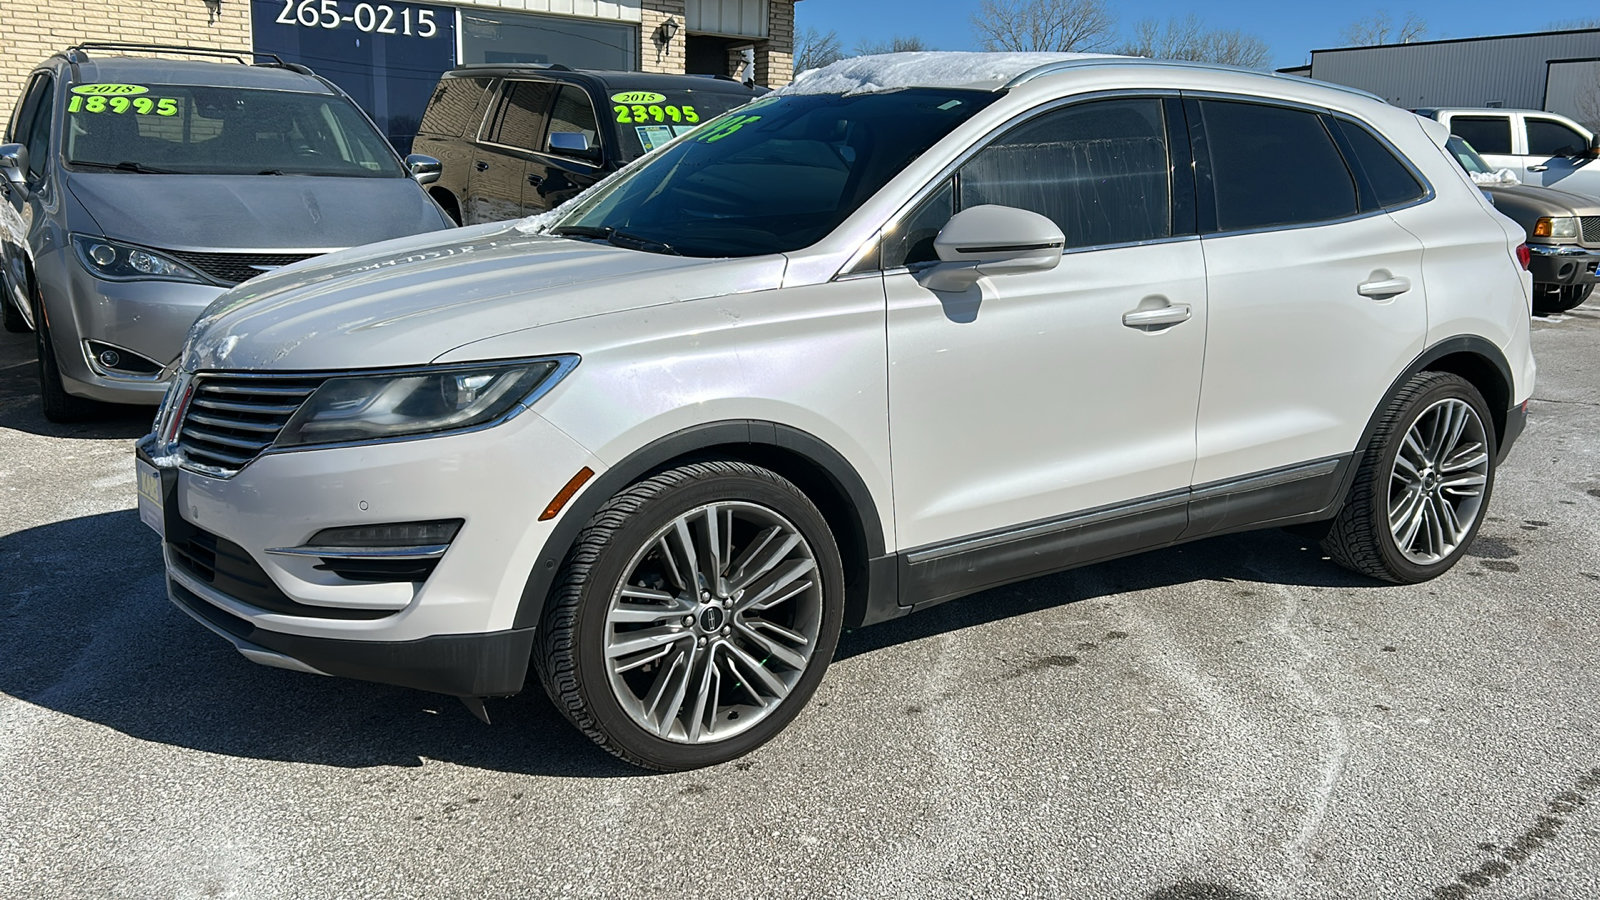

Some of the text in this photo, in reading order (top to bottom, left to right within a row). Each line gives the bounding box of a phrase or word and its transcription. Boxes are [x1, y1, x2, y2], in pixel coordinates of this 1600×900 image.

[276, 0, 437, 38] 265-0215
[84, 86, 136, 94] 2018
[622, 93, 656, 102] 2015
[68, 96, 178, 116] 18995
[613, 105, 700, 123] 23995
